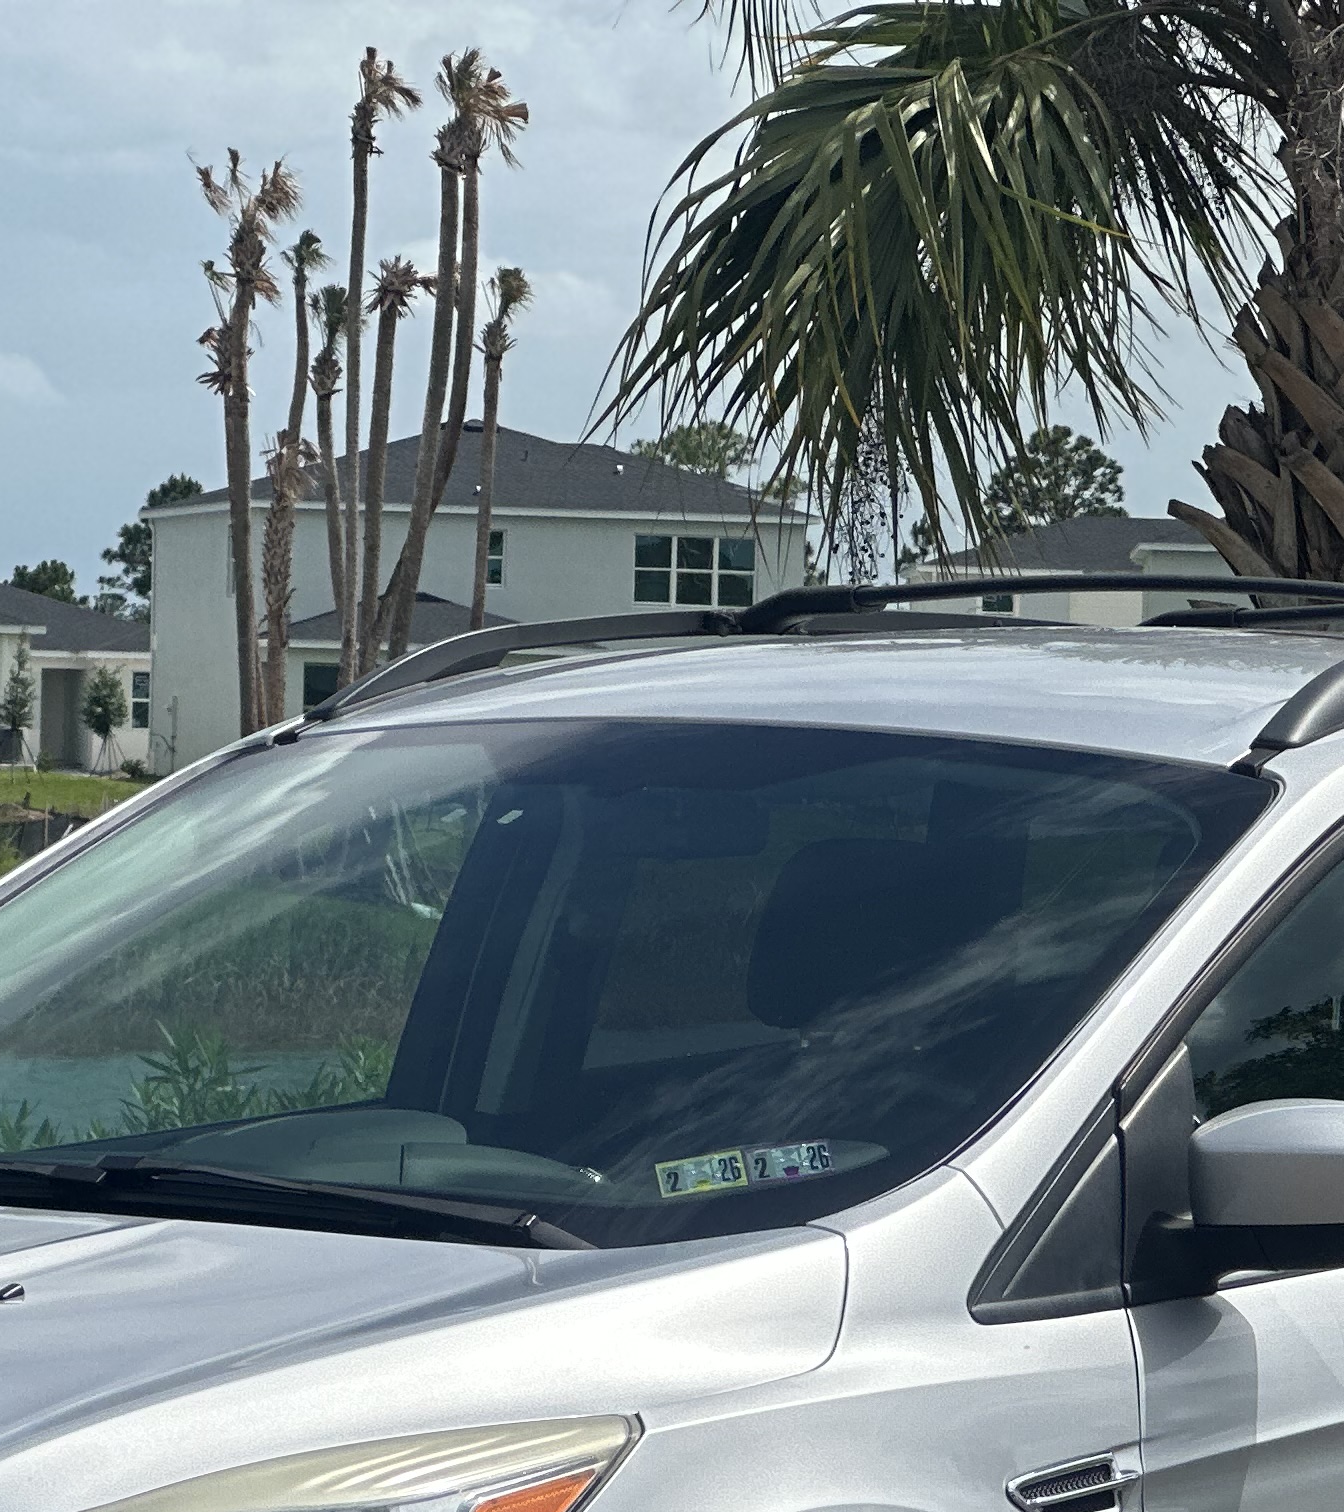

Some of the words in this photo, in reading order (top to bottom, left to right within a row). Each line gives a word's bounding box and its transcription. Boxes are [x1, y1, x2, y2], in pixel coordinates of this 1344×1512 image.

[666, 1172, 683, 1192] 2
[718, 1156, 742, 1182] 26
[755, 1158, 771, 1179] 2
[806, 1144, 830, 1171] 26
